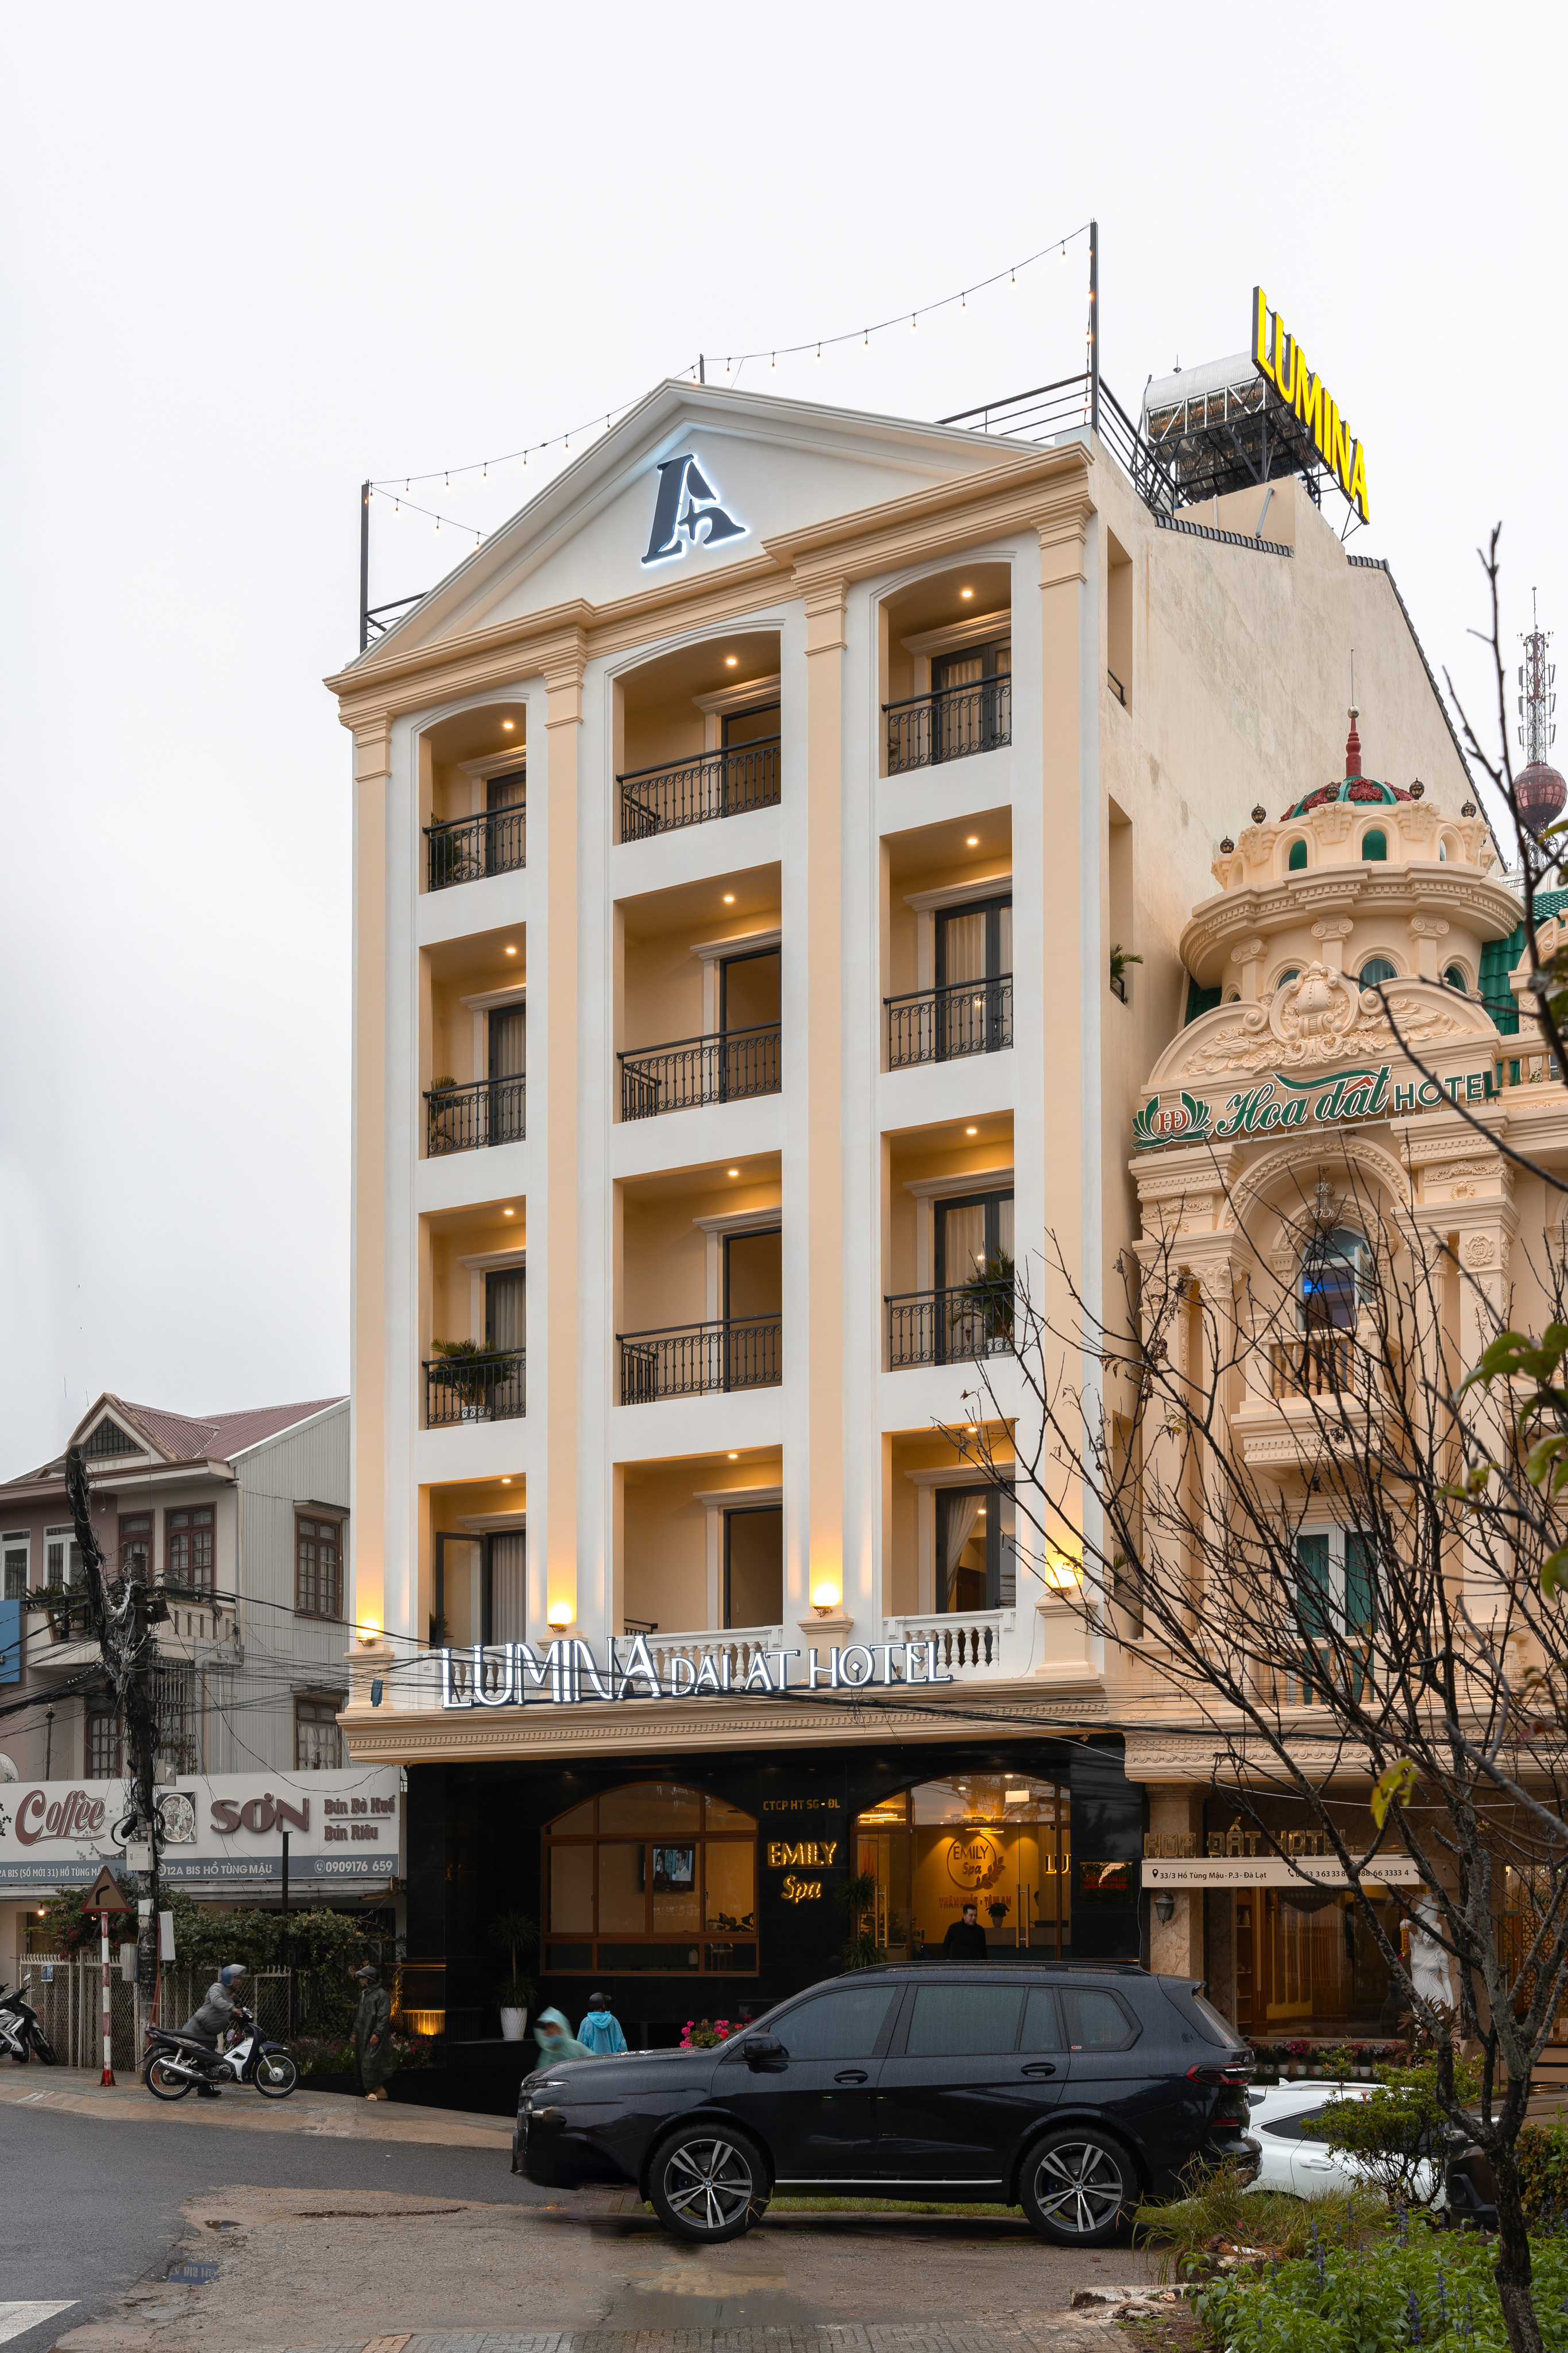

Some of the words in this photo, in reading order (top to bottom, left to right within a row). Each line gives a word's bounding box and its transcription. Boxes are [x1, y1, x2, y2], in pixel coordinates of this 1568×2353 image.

[1251, 286, 1370, 526] LUMINA
[1215, 1082, 1311, 1137] Hoa
[1394, 1070, 1503, 1112] HOTEL
[441, 1634, 662, 1709] LUMINA
[670, 1649, 801, 1696] DALAT
[808, 1640, 954, 1689] HOTEL
[210, 1792, 310, 1833] SƠN
[324, 1797, 349, 1815] Bún
[351, 1796, 368, 1814] Bò
[370, 1794, 396, 1813] Huế
[763, 1800, 789, 1810] CTCP
[790, 1800, 804, 1810] HT
[806, 1799, 819, 1809] SG
[828, 1798, 840, 1808] ĐL
[15, 1789, 107, 1847] Coffee
[324, 1824, 349, 1841] Bún
[351, 1823, 379, 1840] Riêu
[1144, 1832, 1196, 1857] HOA
[1206, 1816, 1261, 1856] ĐẤT
[1269, 1829, 1354, 1855] HOTEL
[767, 1841, 837, 1866] EMILY
[953, 1845, 989, 1860] EMILY
[7, 1869, 18, 1877] BIS
[20, 1866, 31, 1878] (SỐ
[33, 1866, 46, 1877] MỚI
[47, 1868, 59, 1878] 31)
[60, 1866, 69, 1877] HỒ
[71, 1866, 90, 1877] TÙNG
[166, 1866, 184, 1875] 12A
[186, 1866, 201, 1875] BIS
[203, 1861, 219, 1874] HỒ
[221, 1862, 248, 1874] TÙNG
[249, 1862, 272, 1876] MẬU
[326, 1861, 368, 1873] 0909176
[372, 1860, 393, 1872] 659
[962, 1861, 982, 1876] Spa
[1177, 1870, 1187, 1879] Hồ
[1189, 1872, 1207, 1880] Tùng
[1255, 1872, 1267, 1880] Lạt
[780, 1875, 821, 1904] Spa
